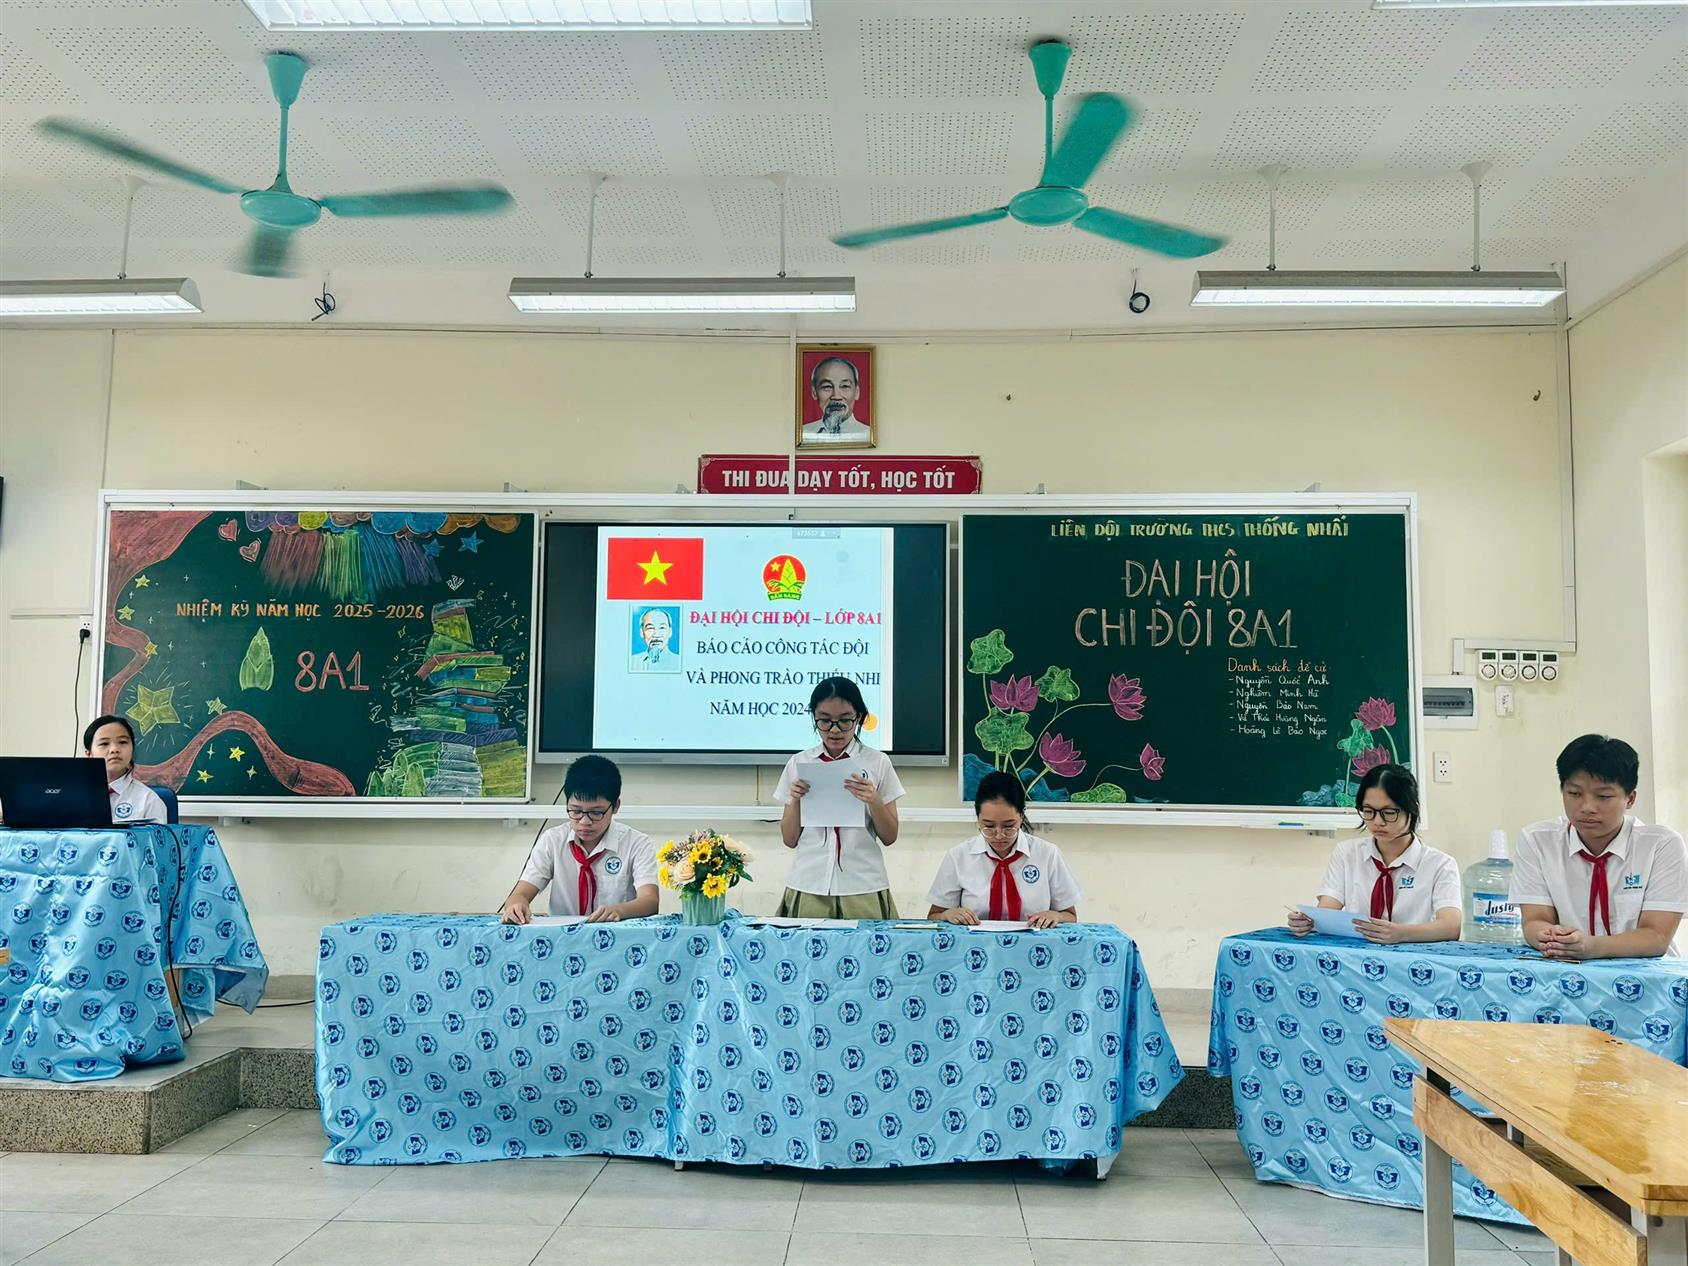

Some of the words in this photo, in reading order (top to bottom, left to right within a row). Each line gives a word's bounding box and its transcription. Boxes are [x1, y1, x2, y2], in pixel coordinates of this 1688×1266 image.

[722, 470, 749, 487] THI
[756, 470, 790, 487] ĐUA
[798, 470, 833, 491] DẠY
[838, 464, 875, 489] TỐT,
[881, 471, 917, 492] HỌC
[923, 465, 955, 489] TỐT
[1051, 519, 1086, 537] LIÊN
[1130, 517, 1193, 537] TRƯỜNG
[1202, 523, 1235, 537] THCS
[1244, 515, 1299, 537] THỐNG
[1121, 559, 1180, 605] ĐẠI
[1196, 548, 1250, 606] HỘI
[176, 599, 222, 622] NHIỆM
[256, 598, 288, 617] NĂM
[295, 603, 321, 621] HỌC
[689, 611, 716, 627] ĐẠI
[720, 609, 748, 627] HỘI
[752, 611, 779, 624] CHI
[782, 609, 810, 627] ĐỘI
[825, 608, 856, 624] LỚP
[857, 611, 881, 625] 8A1
[1075, 607, 1136, 647] CHI
[1146, 600, 1212, 655] ĐỘI
[1228, 608, 1298, 648] 8A1
[697, 638, 728, 654] BÁO
[731, 637, 762, 654] CÁO
[765, 638, 807, 655] CÔNG
[810, 638, 839, 655] TÁC
[843, 639, 869, 657] ĐỘI
[295, 651, 369, 692] 8A1
[1228, 657, 1261, 672] Danh
[686, 668, 707, 684] VÀ
[710, 671, 760, 684] PHONG
[764, 668, 804, 684] TRÀO
[854, 672, 881, 685] NHI
[1307, 674, 1330, 685] Anh
[710, 699, 744, 715] NĂM
[748, 702, 779, 717] HỌC
[1297, 701, 1318, 710] Nam
